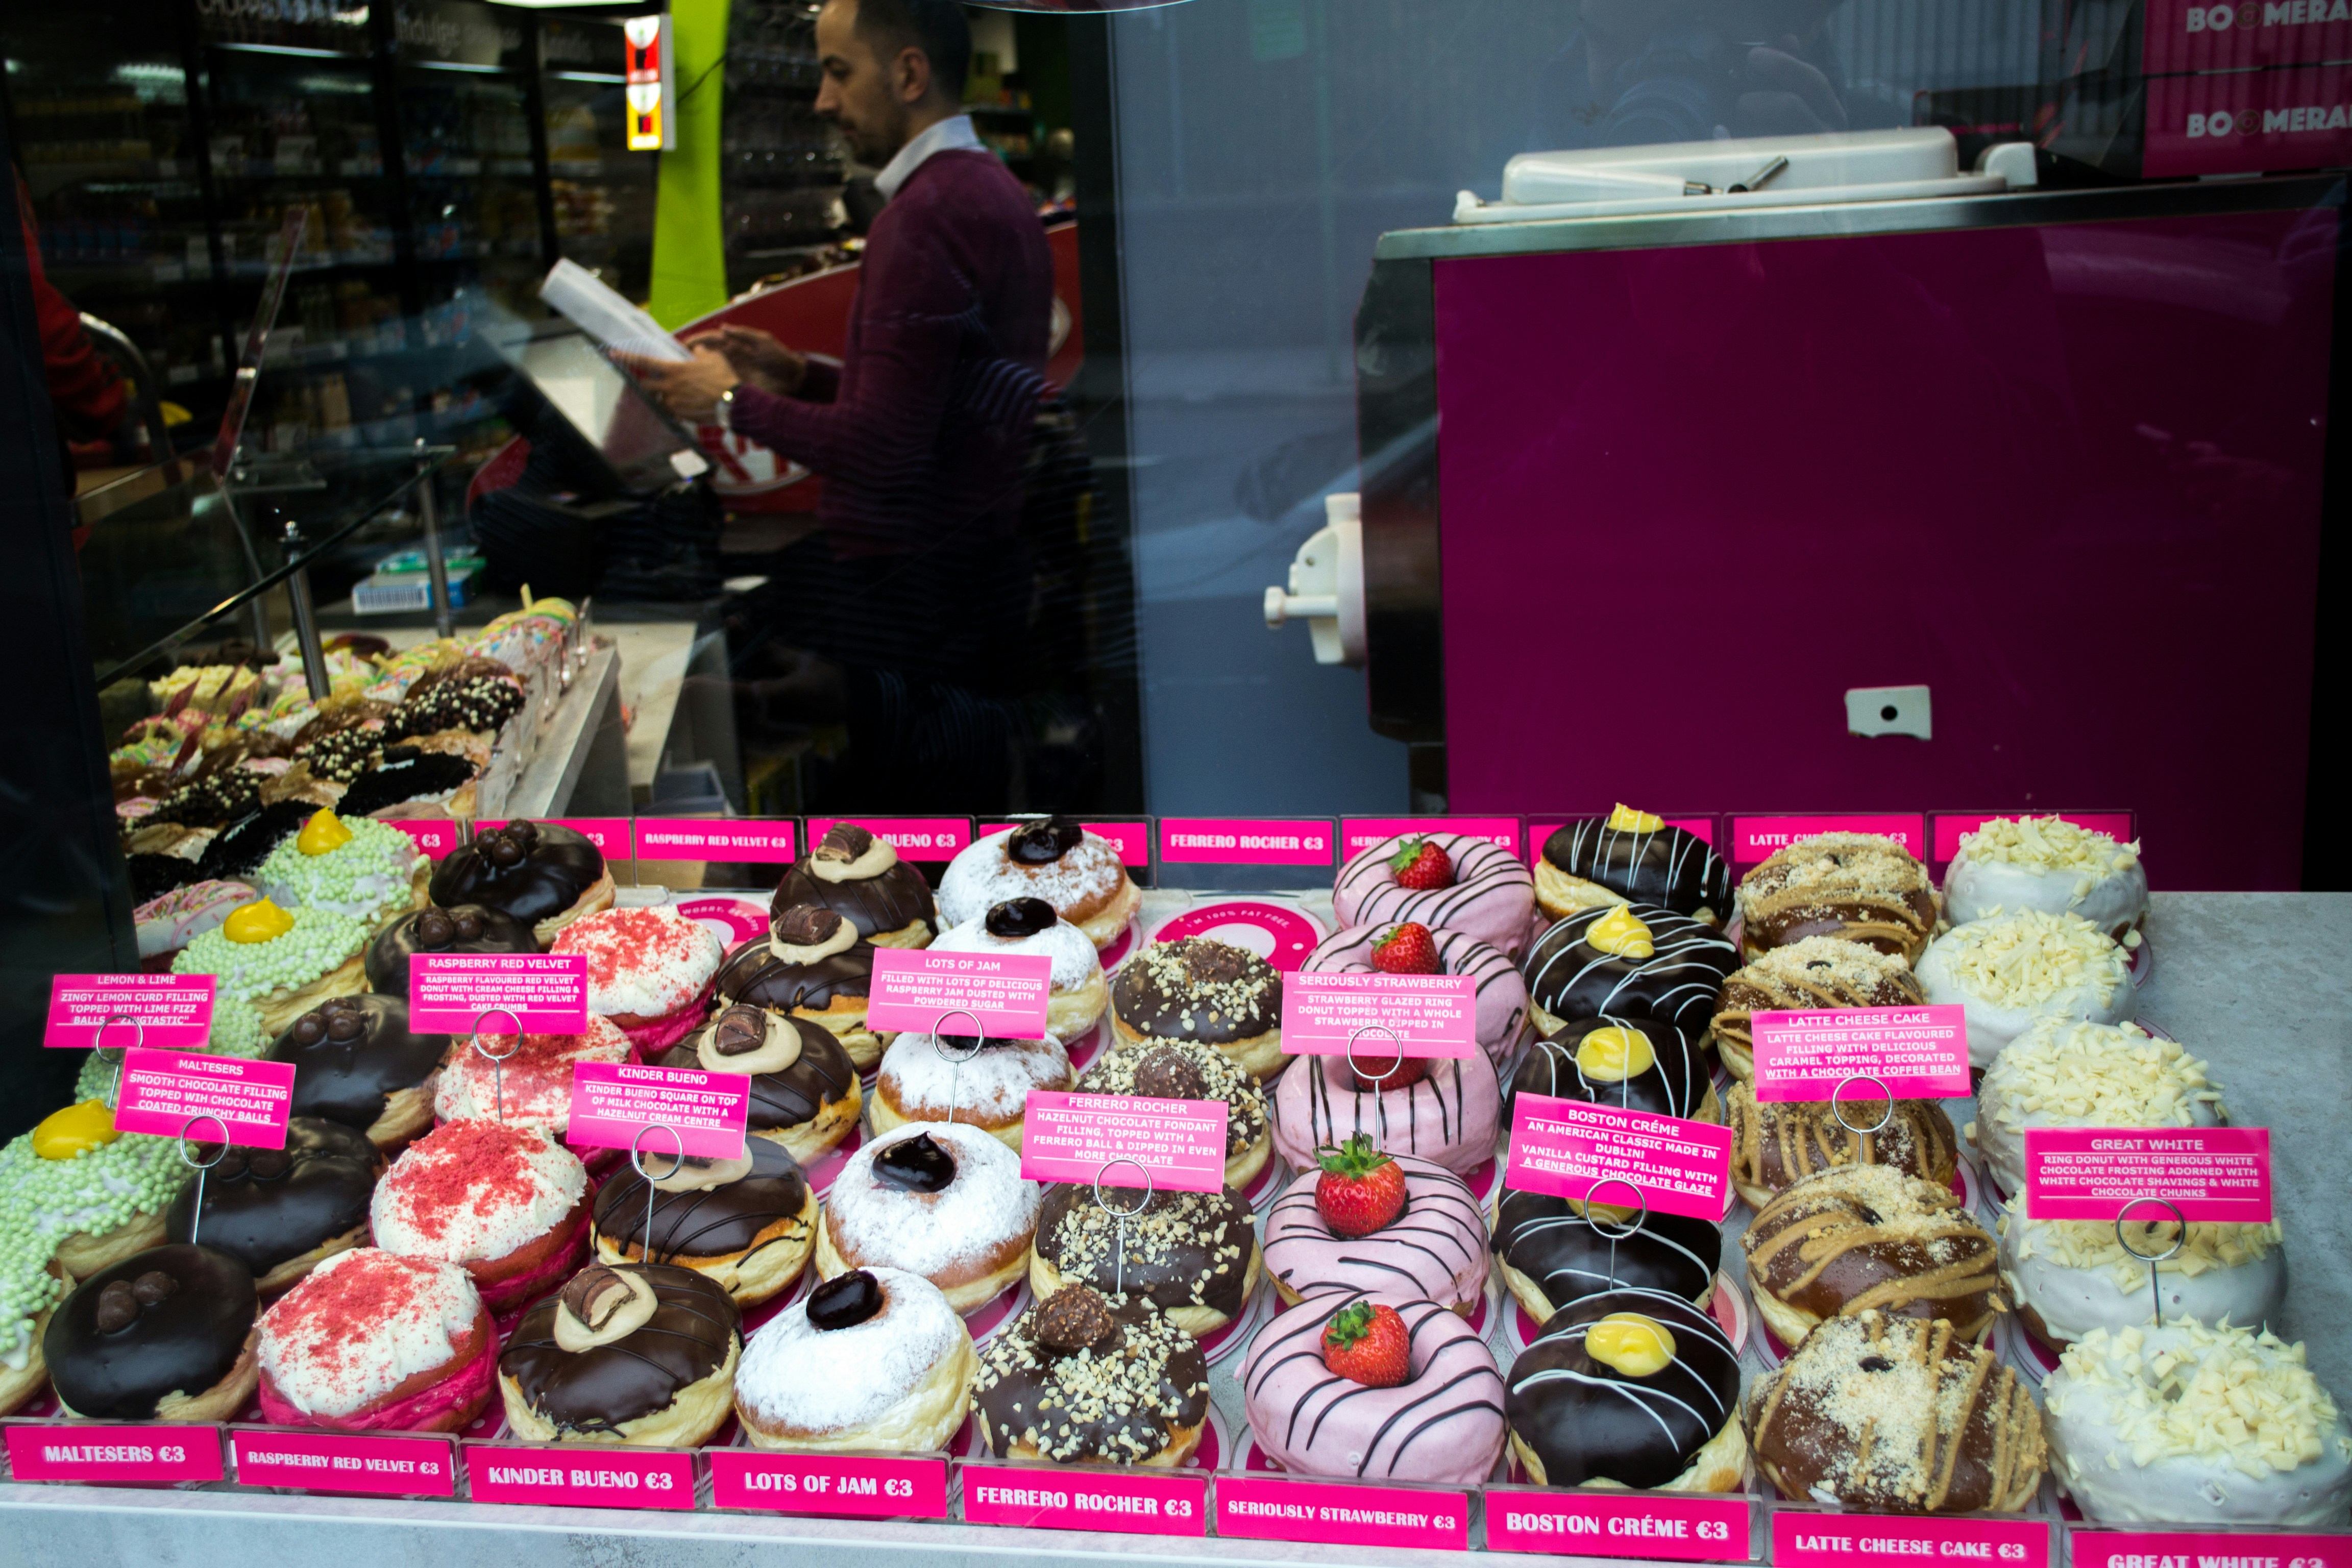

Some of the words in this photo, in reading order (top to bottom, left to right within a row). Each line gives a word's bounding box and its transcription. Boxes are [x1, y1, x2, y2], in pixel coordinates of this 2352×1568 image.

[2187, 0, 2352, 33] BOOMERA
[2187, 105, 2352, 138] BOOMERA
[645, 833, 705, 845] RASPBERRY
[707, 835, 729, 846] RED
[731, 836, 769, 847] VELVET
[771, 837, 786, 848] €3
[882, 834, 932, 847] BUENO
[936, 834, 956, 848] €3
[1170, 834, 1236, 848] FERRERO
[1240, 836, 1300, 850] ROCHER
[1303, 837, 1324, 850] €3
[1494, 836, 1511, 846] €3
[1750, 834, 1788, 846] LATTE
[429, 959, 497, 968] RASPBERRY
[501, 959, 524, 968] RED
[528, 960, 571, 969] VELVET
[925, 958, 955, 969] LOTS
[959, 960, 974, 969] OF
[977, 961, 1000, 971] JAM
[98, 976, 134, 984] LEMON
[138, 976, 145, 984] &
[150, 975, 176, 984] LIME
[881, 974, 914, 984] FILLED
[917, 976, 943, 985] WITH
[946, 978, 970, 987] LOTS
[989, 980, 1042, 990] DELICIOUS
[1299, 976, 1370, 987] SERIOUSLY
[1374, 977, 1462, 989] STRAWBERRY
[61, 993, 94, 1001] ZINGY
[97, 993, 132, 1001] LEMON
[887, 986, 942, 995] RASPBERRY
[945, 988, 963, 996] JAM
[967, 990, 1005, 998] DUSTED
[1009, 992, 1035, 1000] WITH
[1308, 995, 1378, 1004] STRAWBERRY
[1381, 997, 1422, 1006] GLAZED
[1425, 998, 1452, 1007] RING
[70, 1004, 110, 1013] TOPPED
[173, 1004, 197, 1013] FIZZ
[1298, 1006, 1334, 1015] DONUT
[1337, 1007, 1378, 1016] TOPPED
[1381, 1008, 1410, 1017] WITH
[1413, 1009, 1420, 1017] A
[1424, 1009, 1461, 1018] WHOLE
[1788, 1016, 1831, 1027] LATTE
[1835, 1014, 1888, 1025] CHEESE
[1893, 1013, 1929, 1024] CAKE
[1768, 1034, 1801, 1043] LATTE
[1805, 1033, 1848, 1043] CHEESE
[1851, 1031, 1881, 1041] CAKE
[1884, 1030, 1953, 1040] FLAVOURED
[1786, 1044, 1832, 1054] FILLING
[1836, 1043, 1868, 1052] WITH
[1872, 1042, 1936, 1052] DELICIOUS
[179, 1060, 243, 1075] MALTESERS
[1770, 1057, 1822, 1067] CARAMEL
[1825, 1055, 1881, 1065] TOPPING,
[1885, 1053, 1954, 1064] DECORATED
[619, 1068, 664, 1081] KINDER
[667, 1072, 707, 1085] BUENO
[130, 1073, 175, 1086] SMOOTH
[179, 1079, 240, 1094] CHOCOLATE
[244, 1086, 287, 1099] FILLING
[140, 1087, 182, 1100] TOPPED
[211, 1095, 274, 1111] CHOCOLATE
[586, 1085, 622, 1095] KINDER
[625, 1089, 657, 1099] BUENO
[660, 1091, 698, 1102] SQUARE
[702, 1095, 715, 1104] ON
[719, 1096, 737, 1106] TOP
[592, 1096, 604, 1105] OF
[607, 1098, 631, 1108] MILK
[634, 1100, 690, 1113] CHOCOLATE
[693, 1106, 719, 1116] WITH
[722, 1108, 728, 1117] A
[1069, 1097, 1129, 1111] FERRERO
[1133, 1101, 1187, 1114] ROCHER
[1038, 1112, 1094, 1124] HAZELNUT
[1097, 1116, 1160, 1129] CHOCOLATE
[1165, 1121, 1216, 1132] FONDANT
[1569, 1109, 1627, 1128] BOSTON
[1631, 1119, 1679, 1137] CRÉME
[1057, 1125, 1104, 1138] FILLING,
[1108, 1129, 1150, 1140] TOPPED
[1154, 1132, 1184, 1142] WITH
[1188, 1135, 1194, 1143] A
[1528, 1121, 1544, 1132] AN
[1547, 1124, 1608, 1141] AMERICAN
[1612, 1134, 1661, 1150] CLASSIC
[1665, 1142, 1699, 1157] MADE
[1702, 1148, 1716, 1159] IN
[1596, 1144, 1645, 1159] DUBLIN!
[2092, 1139, 2144, 1150] GREAT
[2148, 1139, 2203, 1150] WHITE
[1522, 1144, 1571, 1160] VANILLA
[1575, 1152, 1629, 1168] CUSTARD
[1633, 1161, 1681, 1178] FILLING
[1684, 1170, 1717, 1184] WITH
[2117, 1156, 2148, 1164] WITH
[2151, 1156, 2211, 1165] GENEROUS
[2215, 1157, 2252, 1165] WHITE
[44, 1445, 154, 1462] MALTESERS
[159, 1446, 186, 1462] €3
[249, 1451, 329, 1468] RASPBERRY
[333, 1456, 362, 1469] RED
[365, 1458, 415, 1473] VELVET
[420, 1461, 439, 1475] €3
[489, 1466, 565, 1486] KINDER
[571, 1470, 639, 1489] BUENO
[645, 1472, 673, 1490] €3
[745, 1472, 796, 1491] LOTS
[803, 1475, 832, 1493] OF
[837, 1476, 877, 1496] JAM
[884, 1478, 913, 1497] €3
[977, 1486, 1068, 1508] FERRERO
[1075, 1492, 1158, 1515] ROCHER
[1165, 1496, 1192, 1517] €3
[1228, 1500, 1316, 1520] SERIOUSLY
[1320, 1507, 1429, 1529] STRAWBERRY
[1433, 1514, 1456, 1530] €3
[1507, 1512, 1599, 1535] BOSTON
[1608, 1514, 1688, 1538] CRÉME
[1696, 1522, 1728, 1539] €3
[1795, 1534, 1852, 1552] LATTE
[1859, 1536, 1933, 1555] CHEESE
[1940, 1540, 1992, 1558] CAKE
[1997, 1541, 2024, 1559] €3
[2108, 1554, 2190, 1568] GREAT
[2197, 1555, 2279, 1568] WHITE
